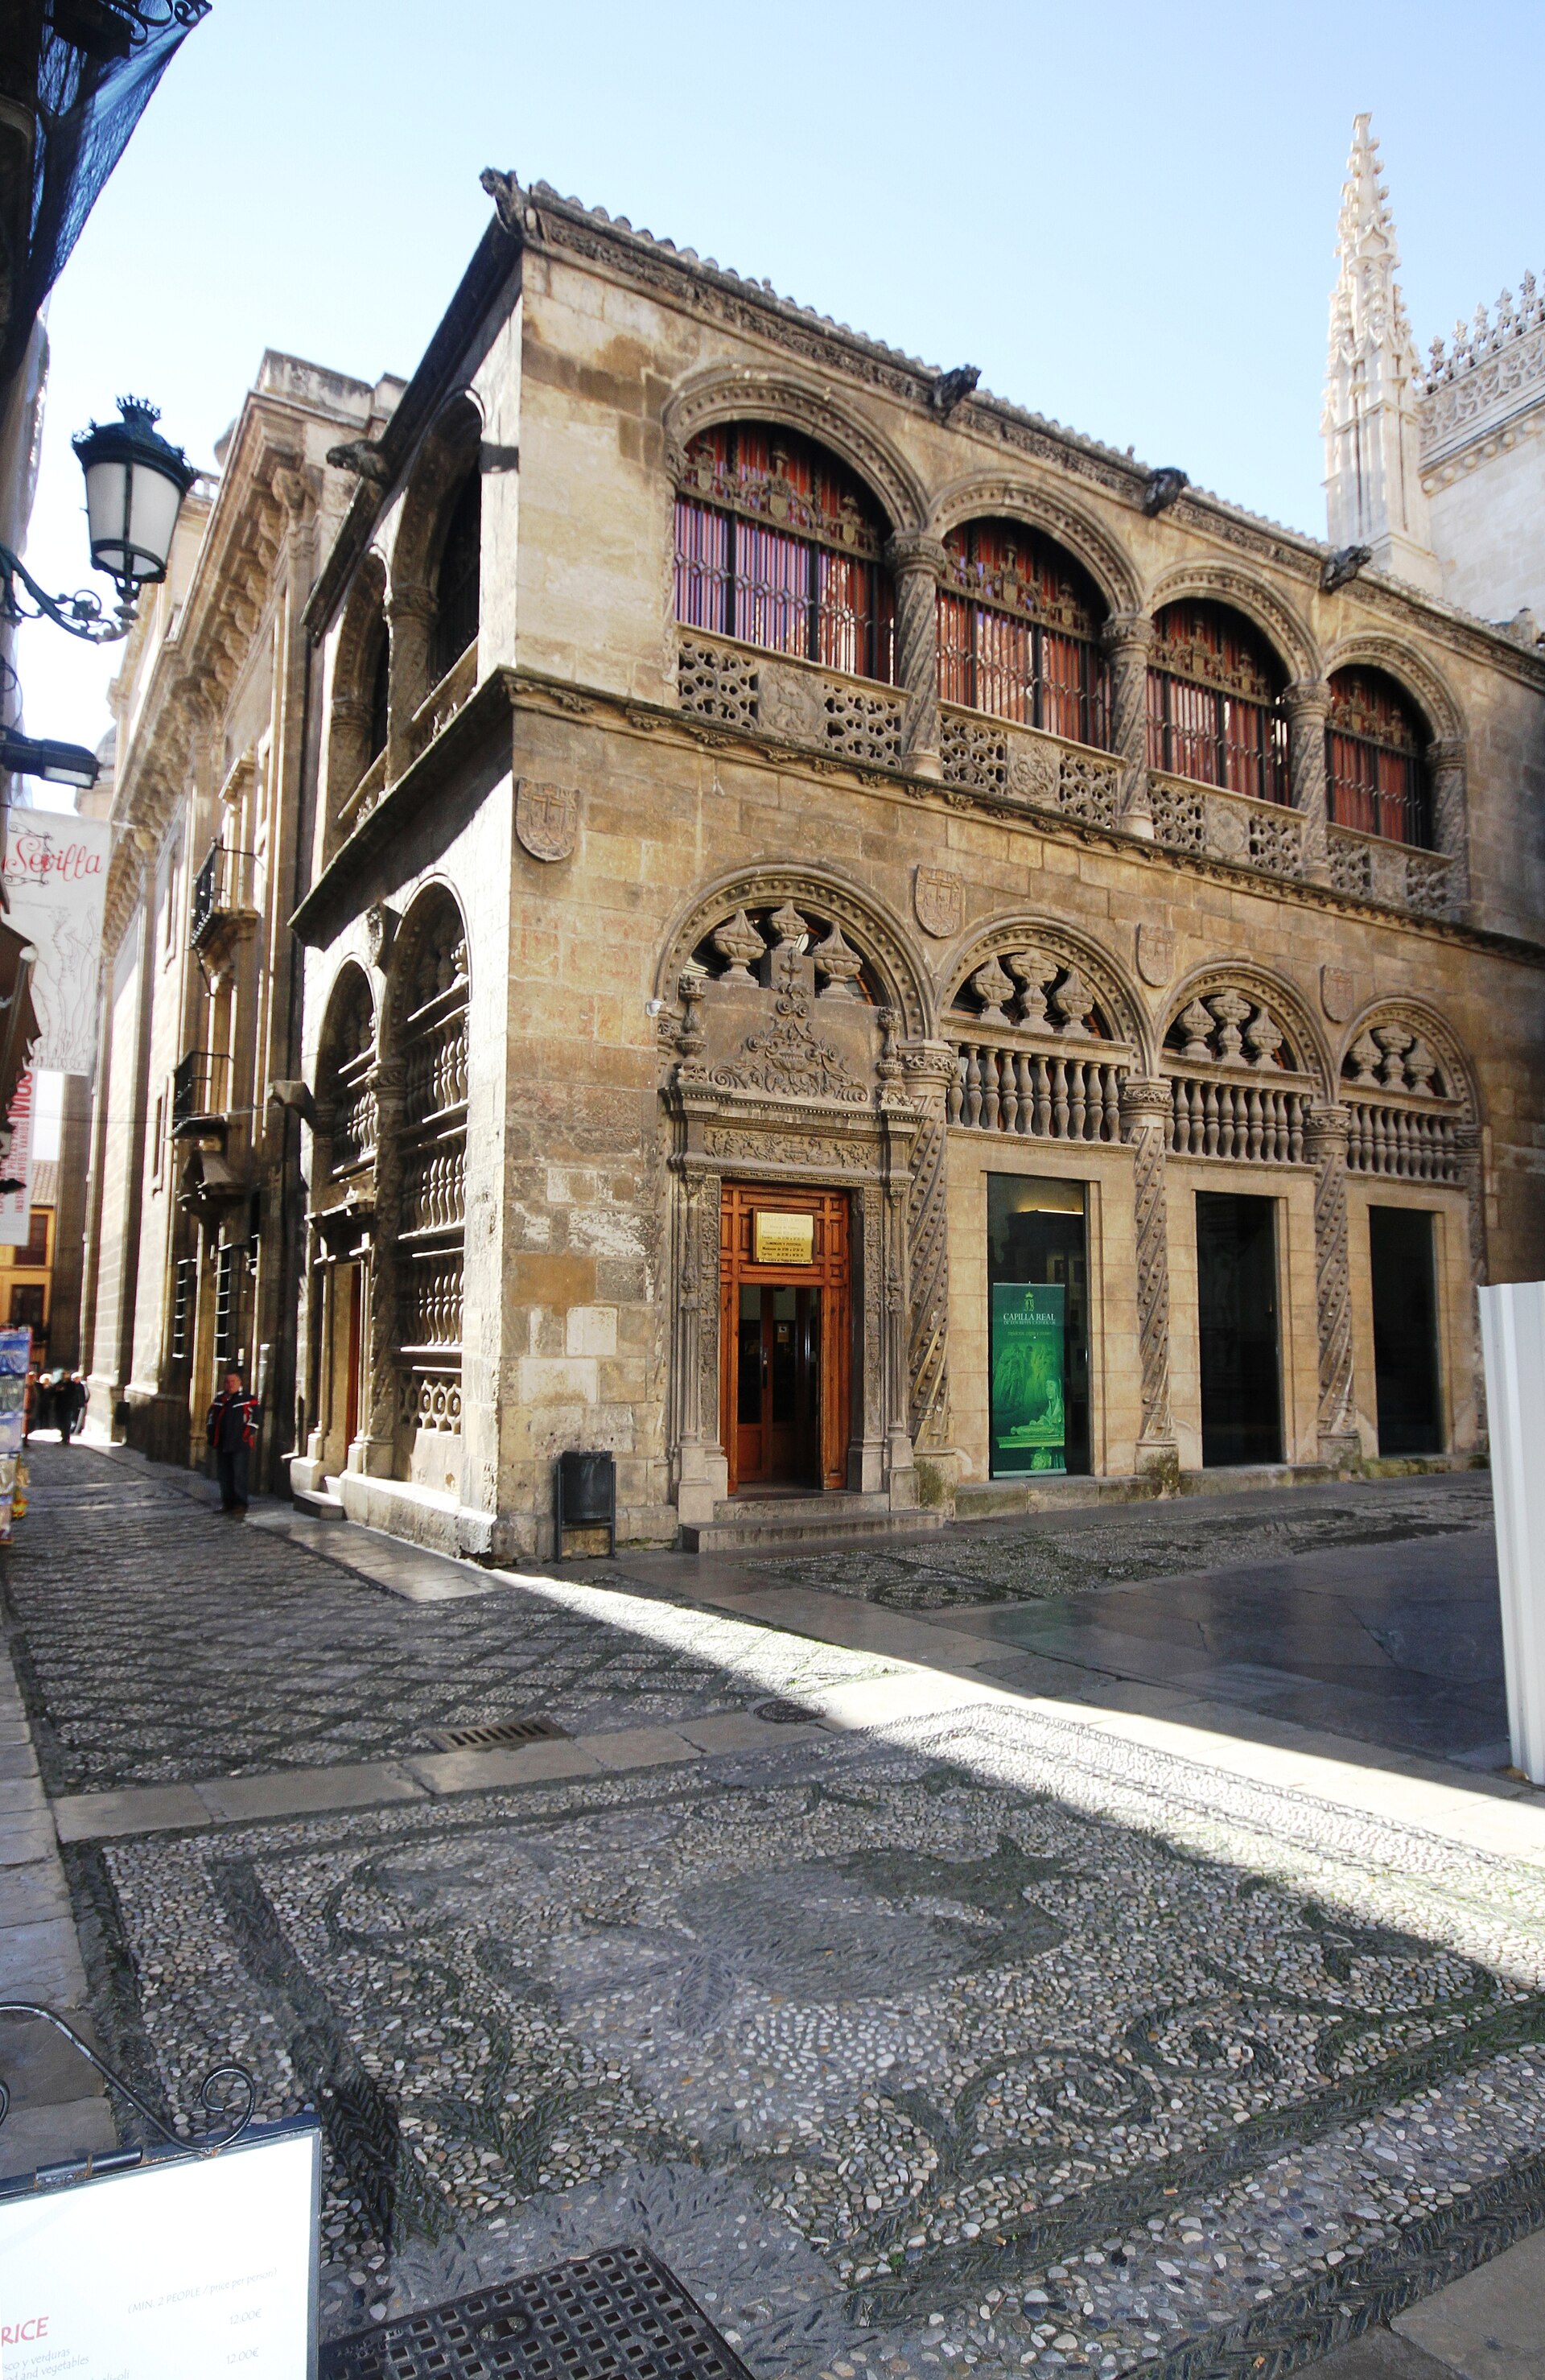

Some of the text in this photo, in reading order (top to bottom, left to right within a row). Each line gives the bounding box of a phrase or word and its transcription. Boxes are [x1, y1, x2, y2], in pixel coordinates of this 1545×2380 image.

[6, 836, 102, 881] Sevilla
[14, 1151, 27, 1214] INSTRMENTOS
[1003, 1313, 1056, 1321] CAPILLA REAL
[128, 2300, 154, 2314] (MIN.
[157, 2296, 164, 2306] 2
[166, 2287, 201, 2304] PEOPLE
[210, 2281, 230, 2295] price
[232, 2278, 245, 2290] per
[247, 2267, 278, 2286] person)
[229, 2308, 262, 2325] 12.00€
[2, 2316, 49, 2347] RICE
[23, 2359, 29, 2370] y
[31, 2348, 71, 2365] verduras
[41, 2354, 89, 2377] vegetables
[226, 2347, 259, 2365] 12.00€
